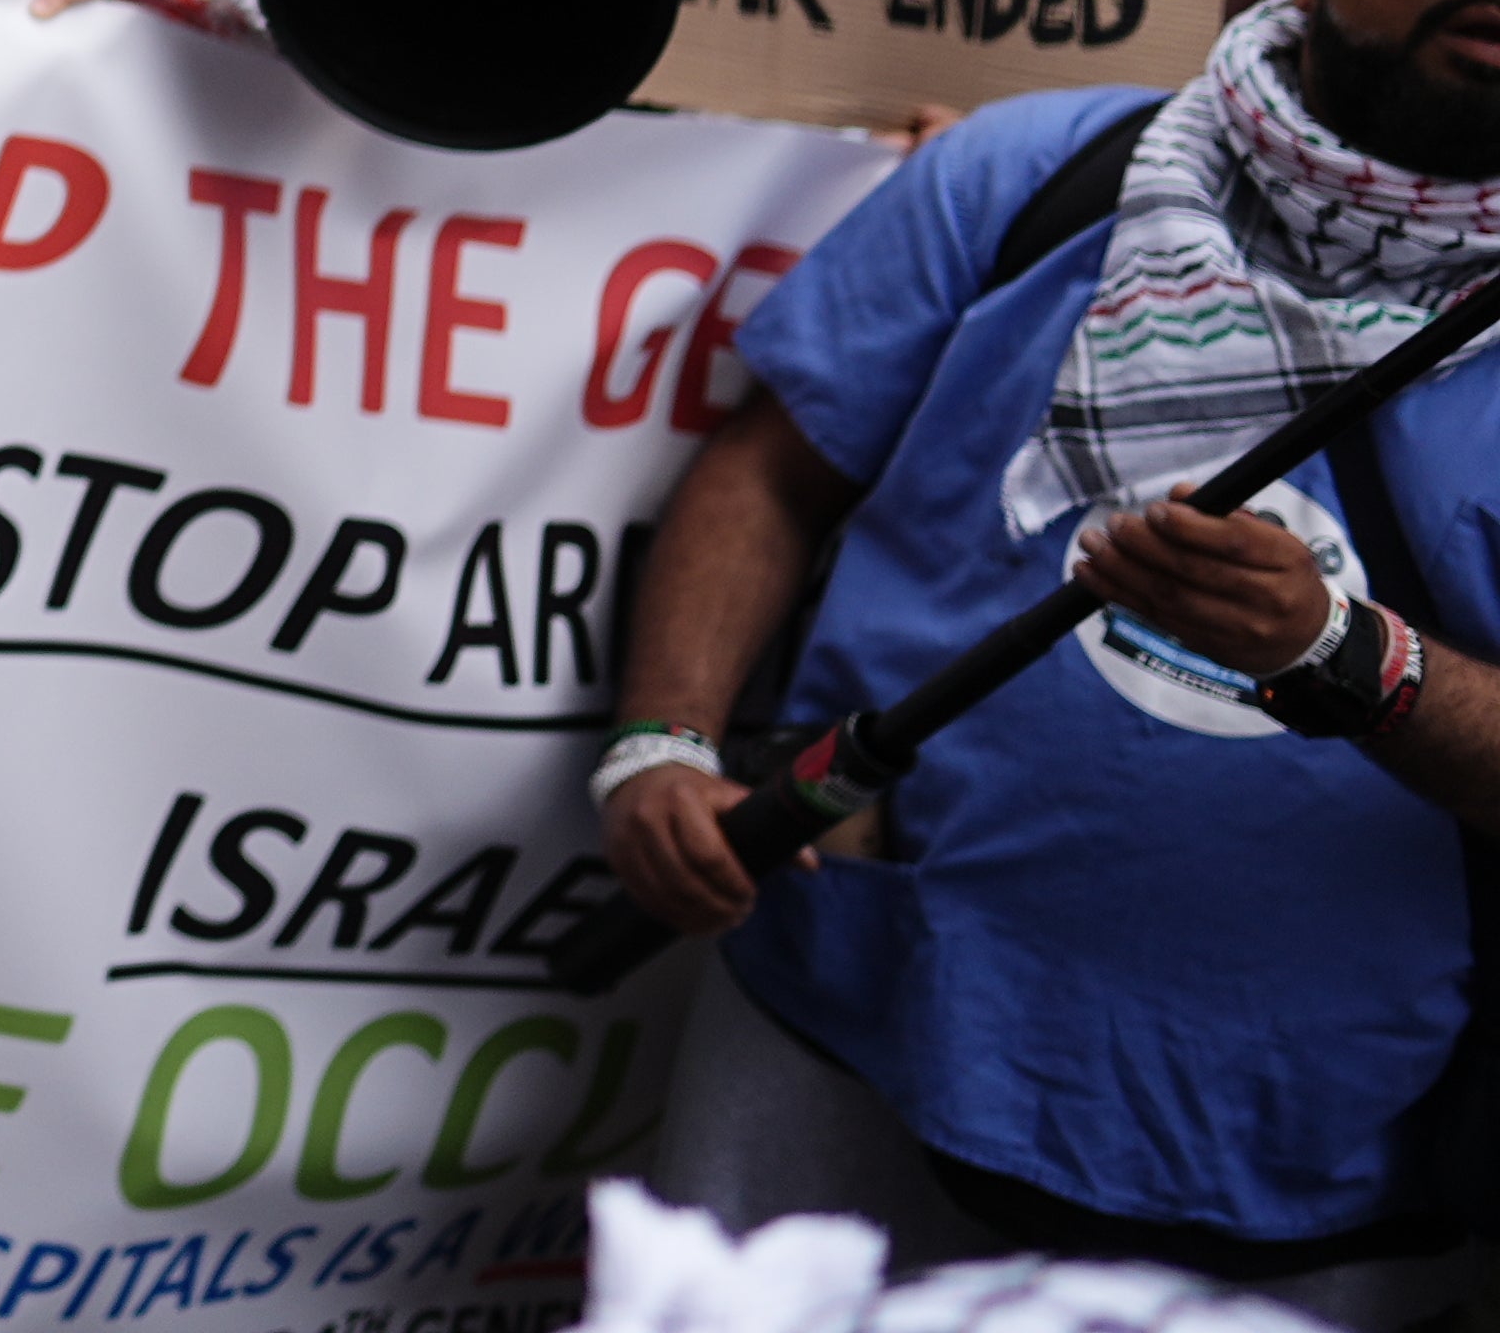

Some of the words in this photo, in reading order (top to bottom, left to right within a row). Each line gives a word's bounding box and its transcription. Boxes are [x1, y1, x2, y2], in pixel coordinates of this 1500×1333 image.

[176, 166, 528, 430] THE
[425, 518, 656, 687] AR
[313, 1221, 417, 1289] IS
[409, 1207, 484, 1281] A
